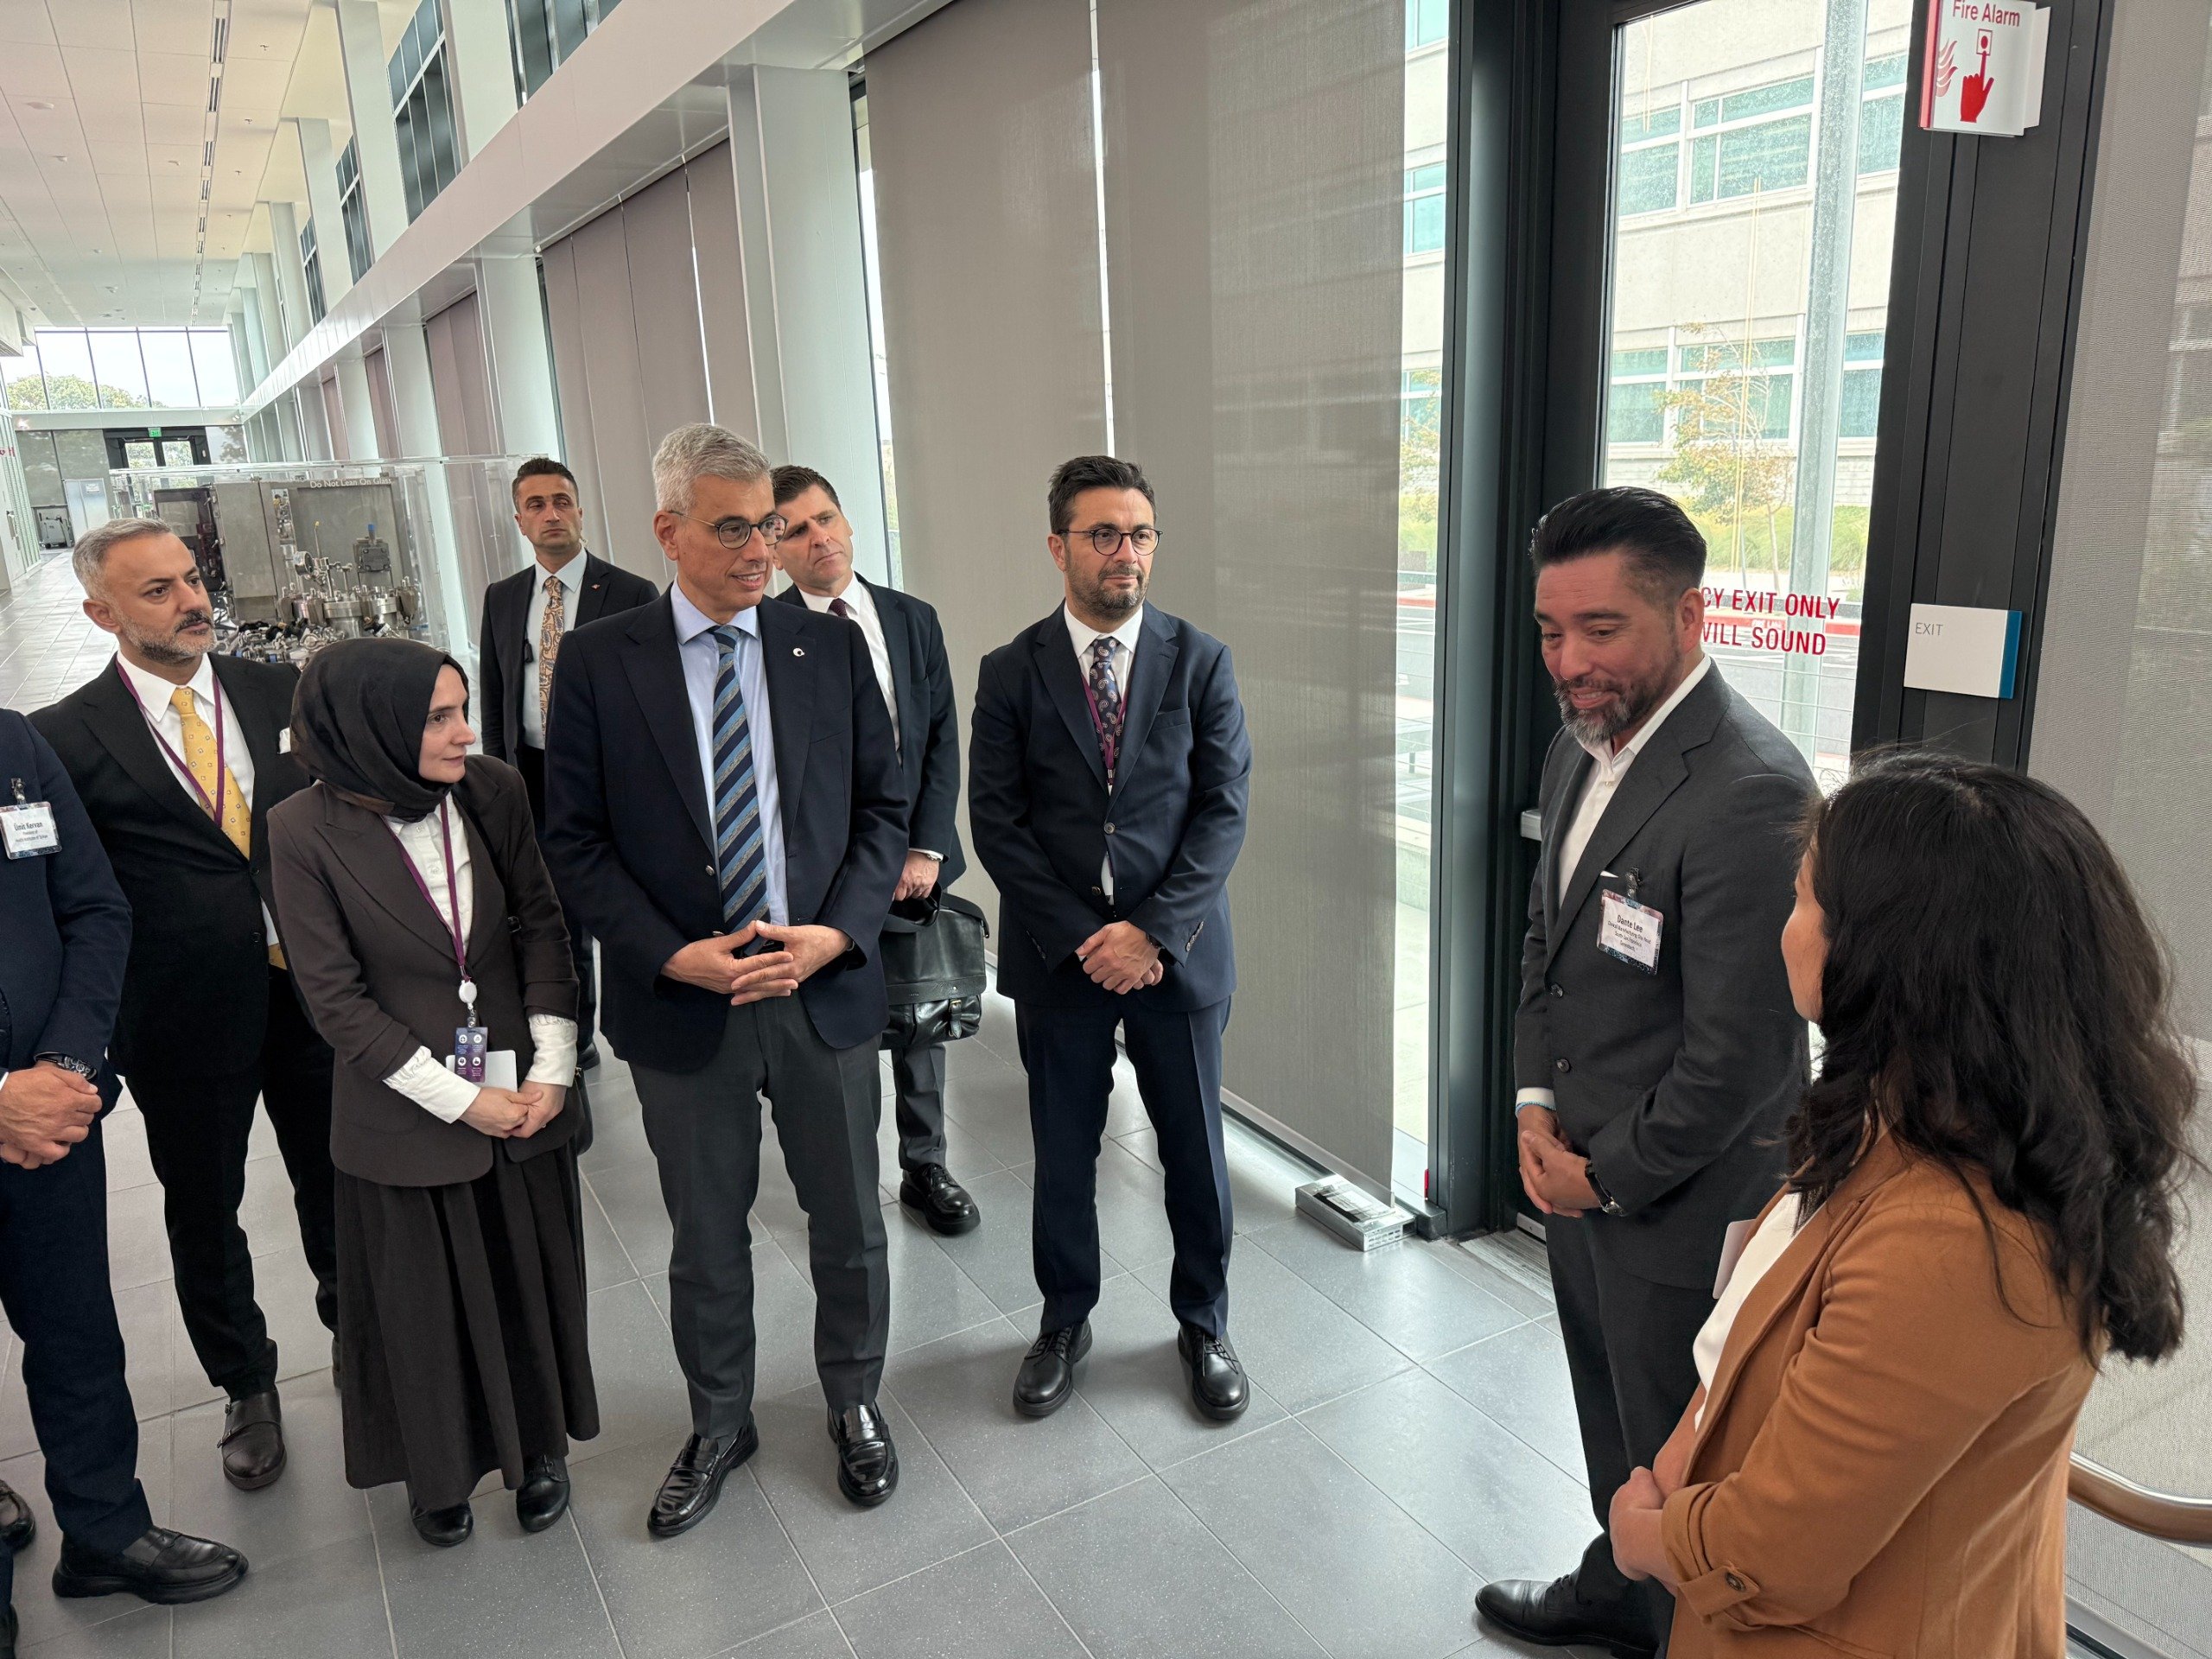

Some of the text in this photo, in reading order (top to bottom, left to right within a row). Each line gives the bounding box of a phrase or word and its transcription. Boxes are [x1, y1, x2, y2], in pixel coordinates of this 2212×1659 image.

[1953, 0, 2020, 27] Fire Alarm
[1732, 589, 1777, 613] EXIT
[1785, 593, 1840, 620] ONLY
[1751, 626, 1826, 656] SOUND
[1916, 622, 1943, 636] EXIT
[1618, 914, 1643, 933] Dante Lee
